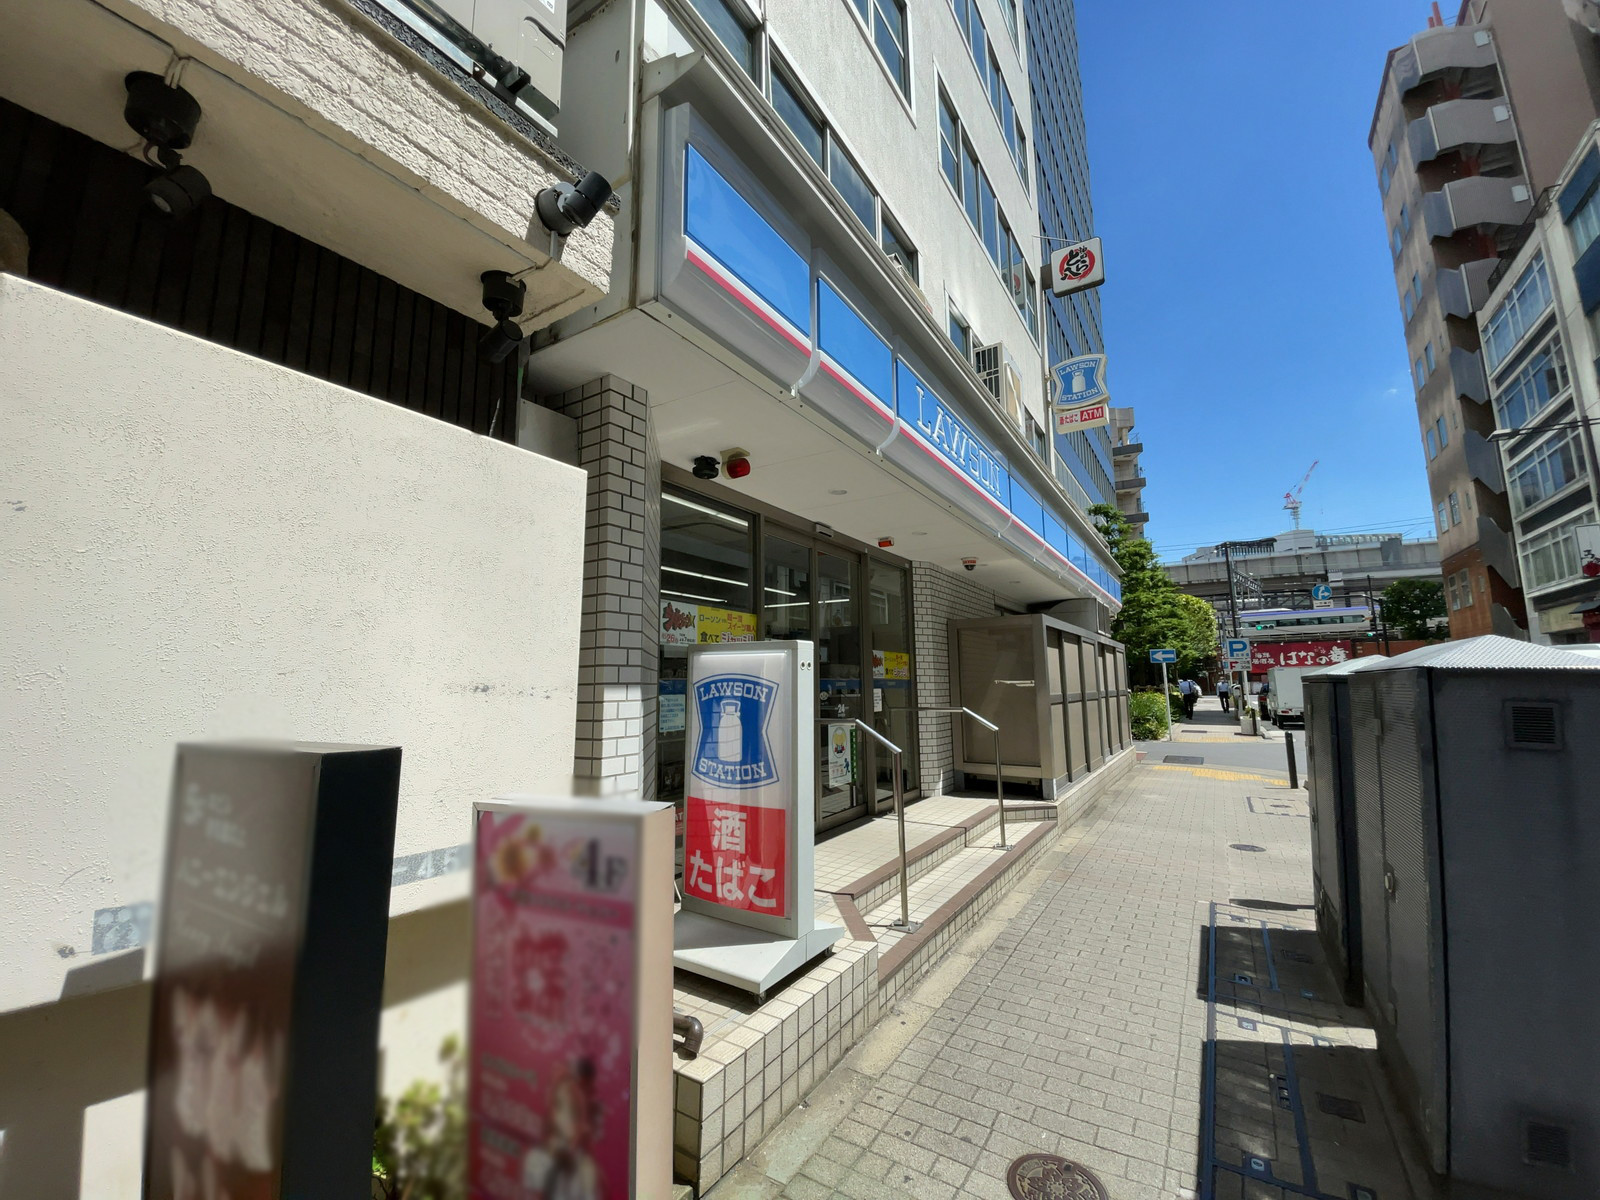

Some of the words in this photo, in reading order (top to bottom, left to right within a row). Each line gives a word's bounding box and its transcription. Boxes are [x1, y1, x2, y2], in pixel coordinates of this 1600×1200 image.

[1059, 359, 1097, 376] LAWSON
[1061, 387, 1099, 401] STATION
[1081, 407, 1103, 421] ATM
[915, 384, 1002, 498] LAWSON
[699, 614, 721, 624] ローソン
[700, 631, 720, 643] 食べて
[1228, 640, 1248, 657] P
[699, 681, 769, 703] LAWSON
[697, 758, 768, 781] STATION
[711, 807, 747, 855] 酒
[570, 838, 628, 892] 4F
[689, 850, 777, 909] たばこ
